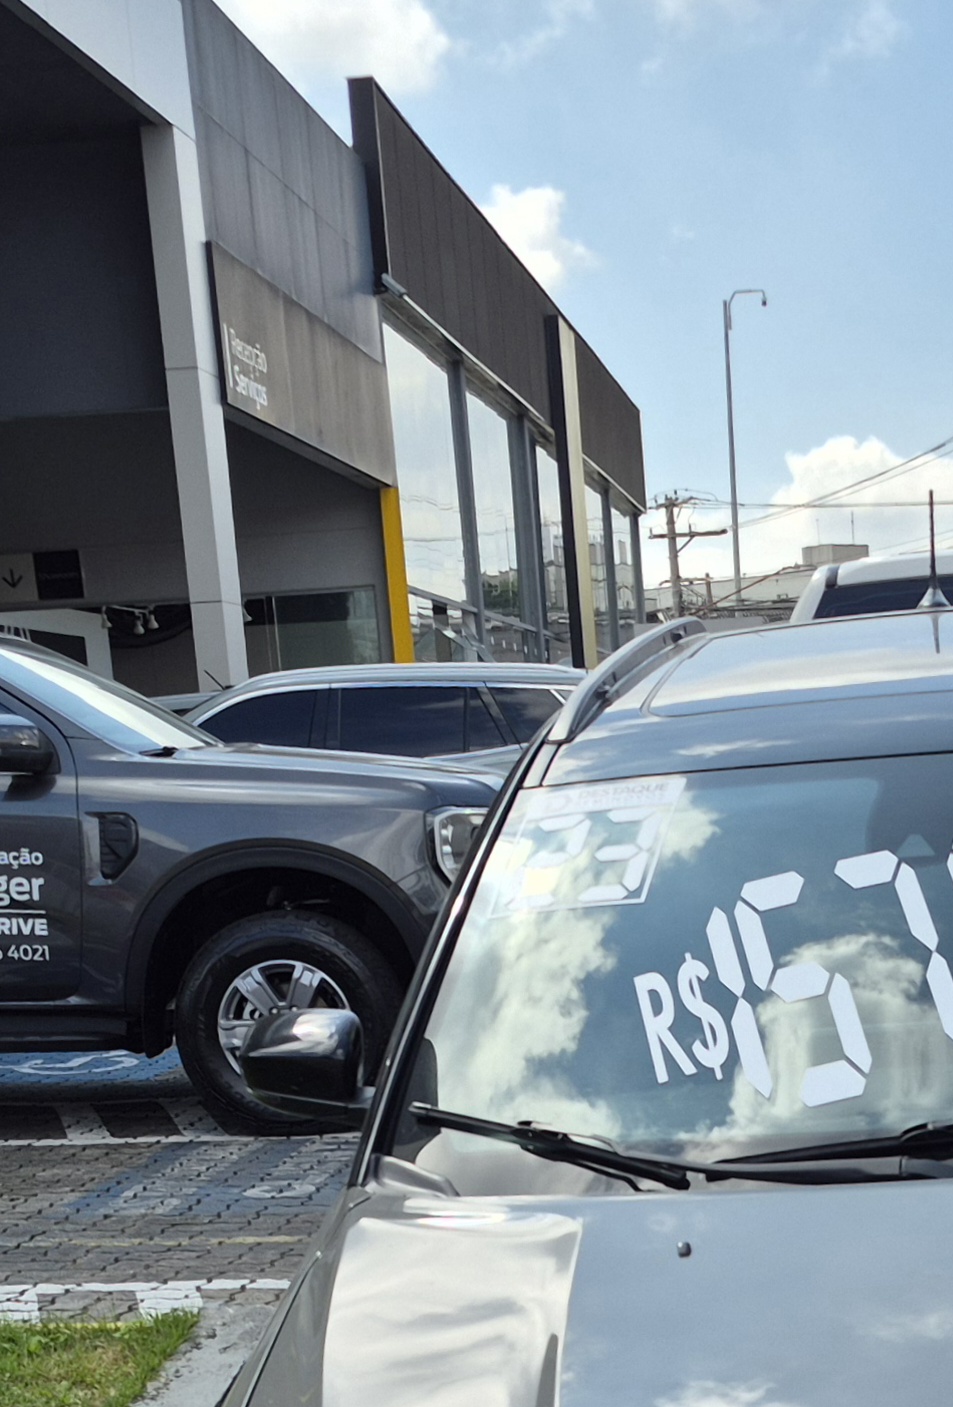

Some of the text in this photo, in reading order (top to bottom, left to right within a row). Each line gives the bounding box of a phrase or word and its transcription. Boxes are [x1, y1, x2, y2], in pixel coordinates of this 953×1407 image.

[228, 327, 268, 376] Recepção
[232, 364, 268, 411] Serviços
[7, 944, 50, 961] 4021
